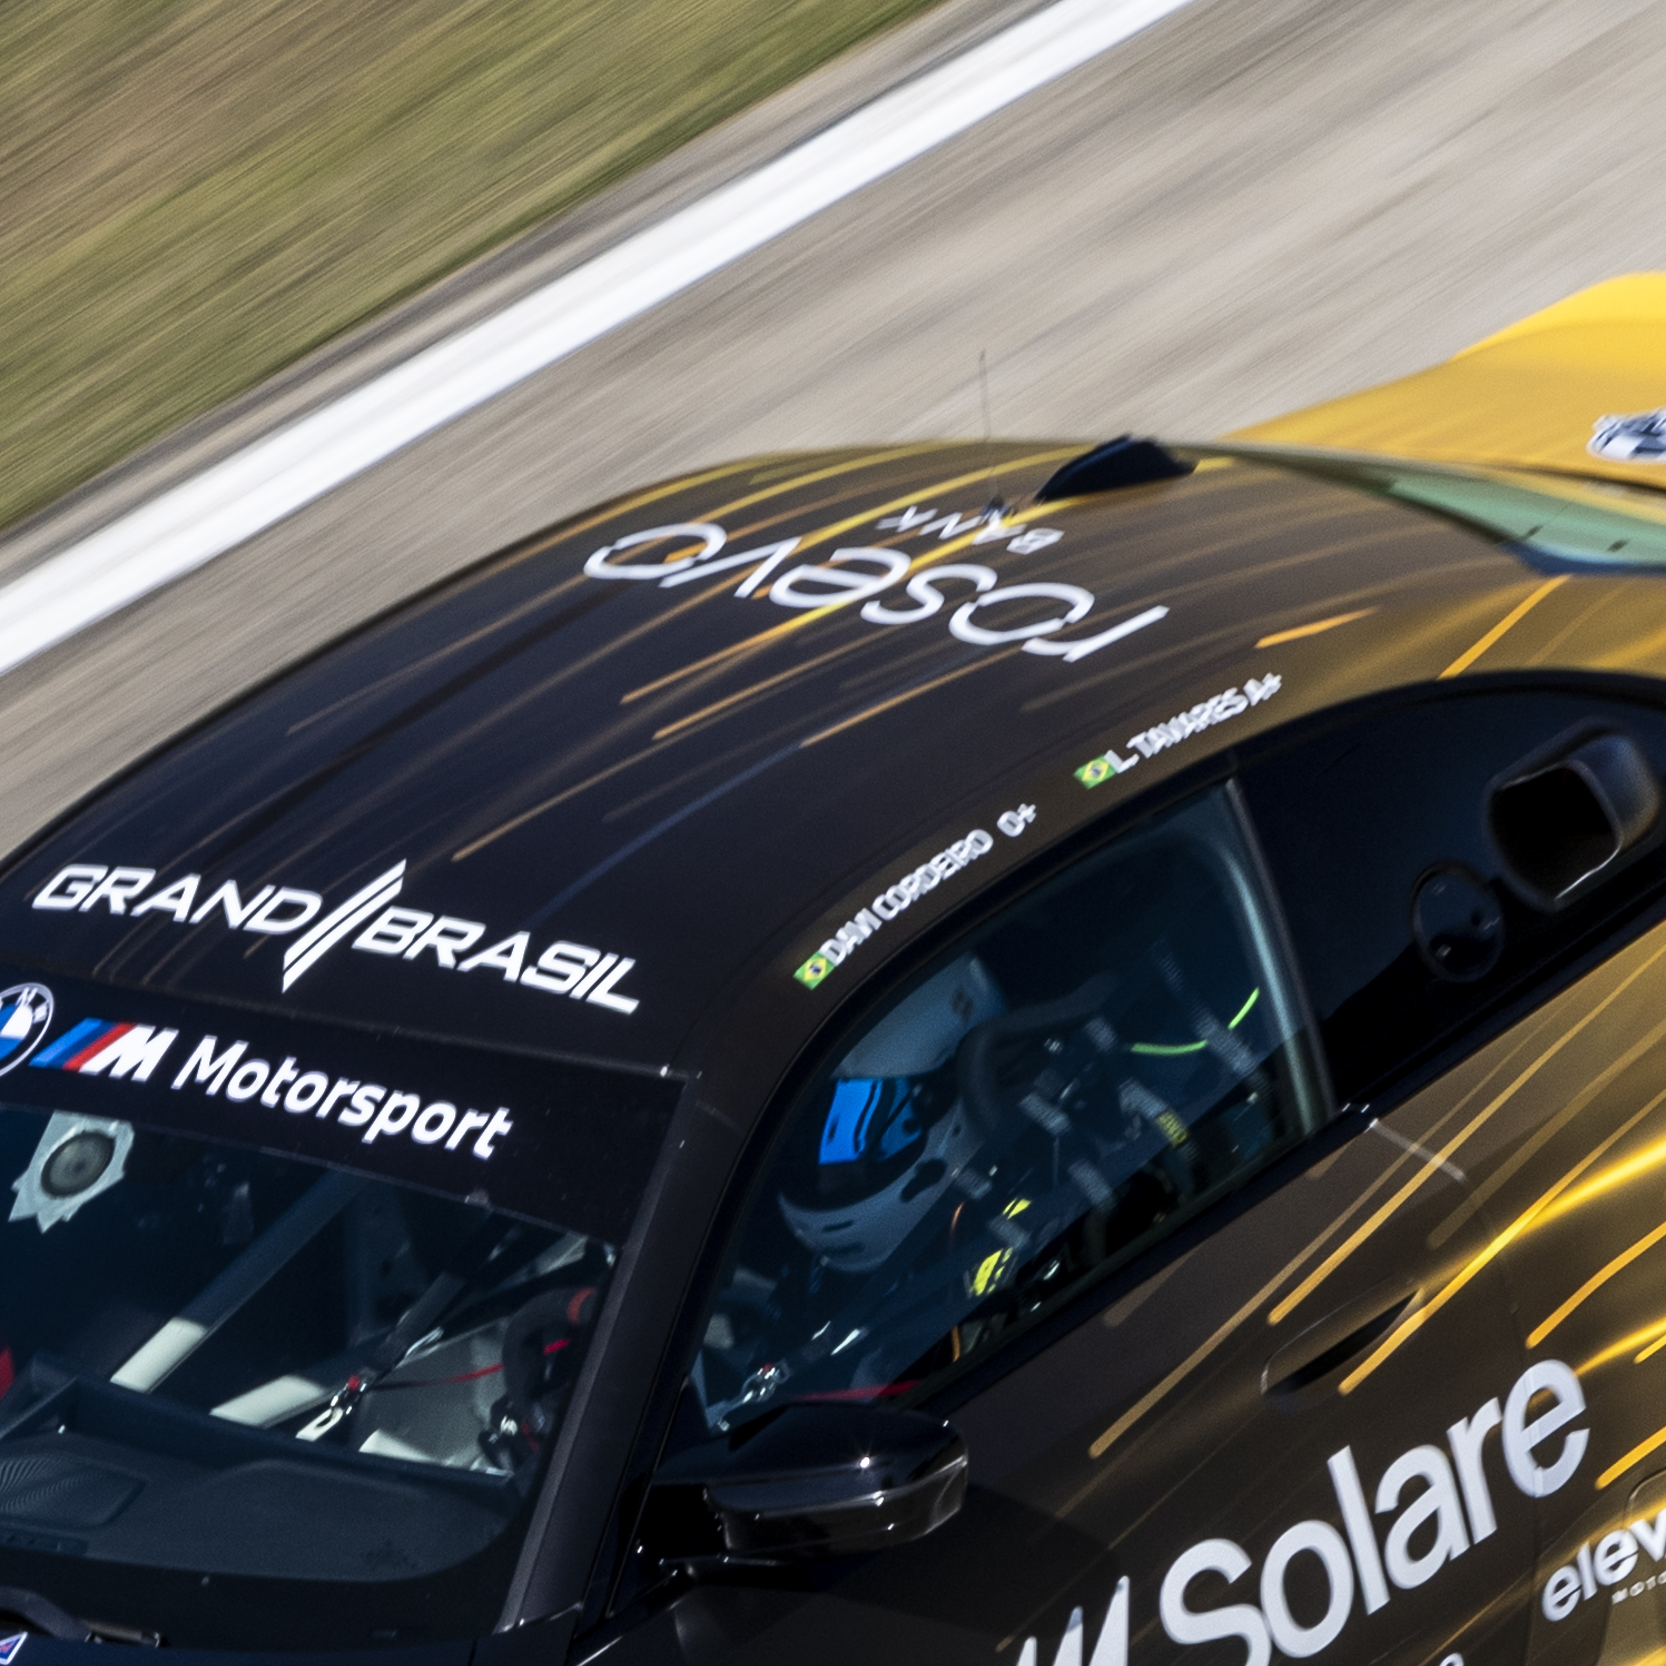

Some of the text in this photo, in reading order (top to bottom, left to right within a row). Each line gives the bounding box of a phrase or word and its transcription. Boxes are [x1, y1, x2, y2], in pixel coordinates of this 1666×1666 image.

[583, 522, 1170, 662] rosevo
[875, 505, 1065, 555] BANK
[1126, 687, 1250, 759] TAVARES
[31, 863, 641, 1015] GRAND BRASIL
[819, 907, 882, 967] DAVI
[871, 829, 994, 920] CORDEIRO
[170, 1034, 514, 1162] Motorsport
